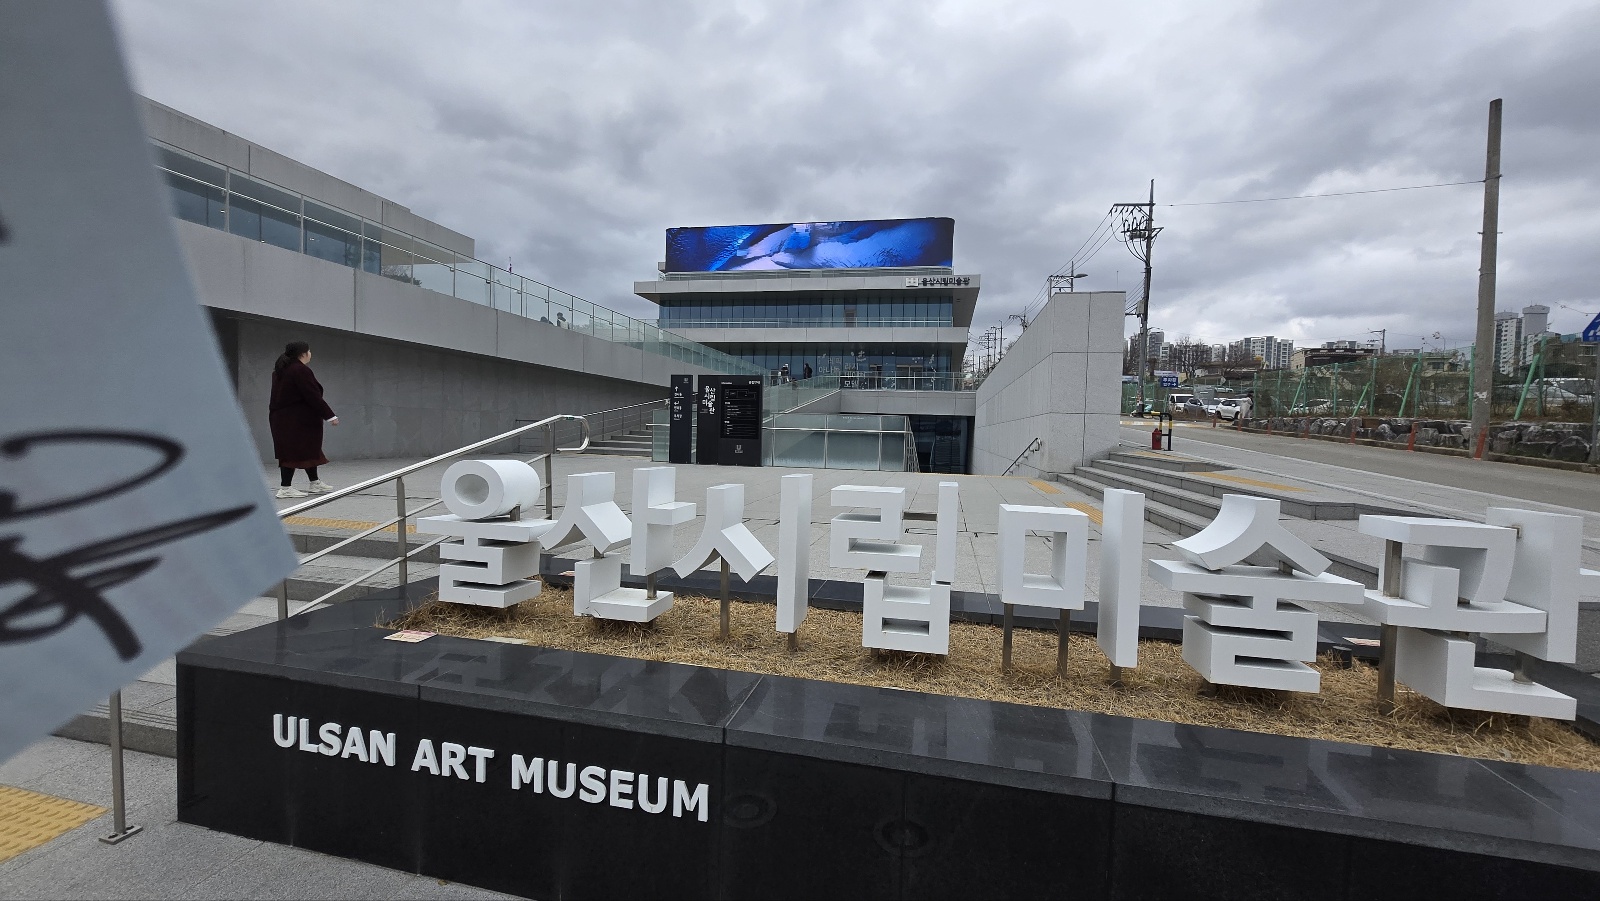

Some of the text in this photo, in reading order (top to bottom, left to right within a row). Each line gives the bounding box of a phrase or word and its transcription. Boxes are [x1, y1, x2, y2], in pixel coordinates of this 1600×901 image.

[921, 276, 971, 287] 울산시립미술관
[417, 459, 1600, 722] 울산시립미술관
[272, 713, 709, 823] ULSAN ART MUSEUM
